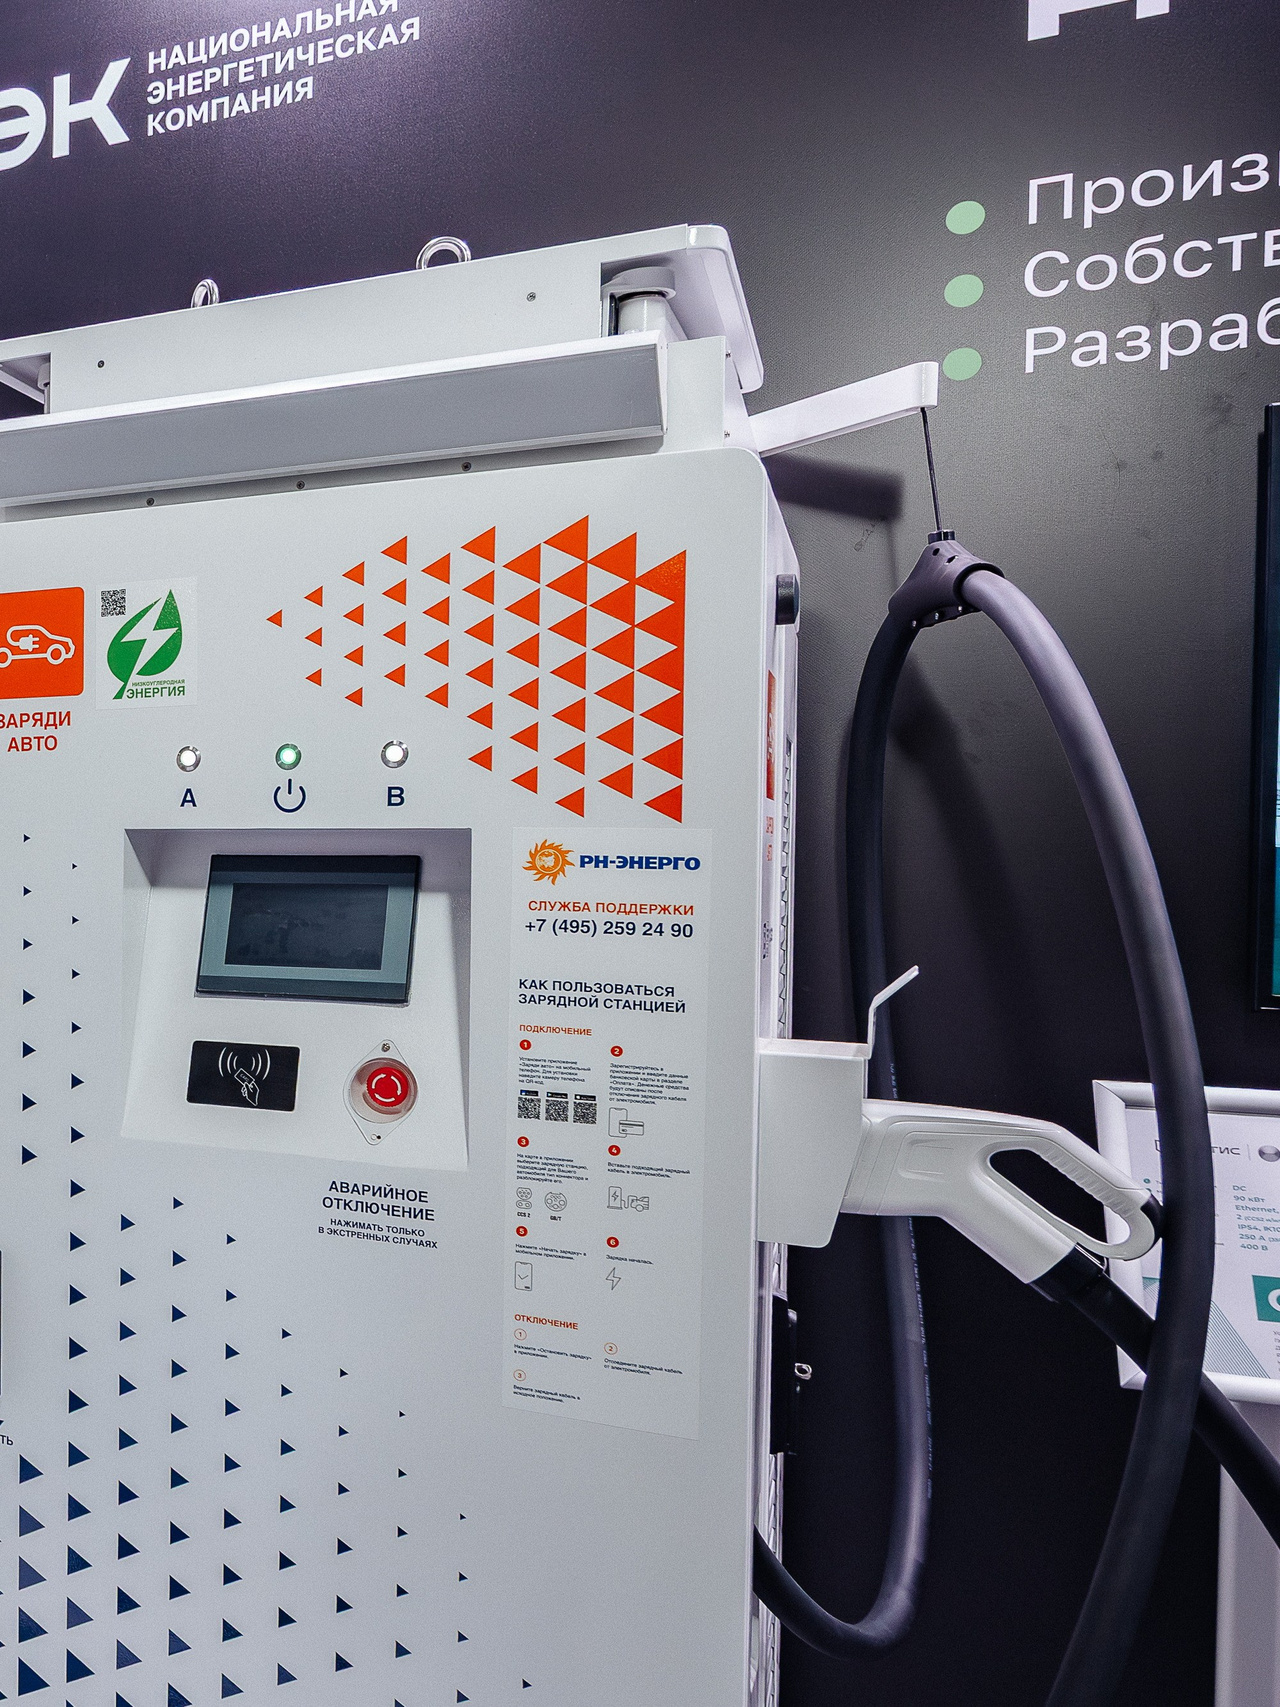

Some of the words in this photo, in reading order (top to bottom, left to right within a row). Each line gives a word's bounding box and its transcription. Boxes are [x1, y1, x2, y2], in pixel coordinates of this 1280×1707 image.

[148, 0, 401, 73] НАЦИОНАЛЬНАЯ
[147, 17, 421, 105] ЭНЕРГЕТИЧЕСКАЯ
[147, 77, 314, 136] КОМПАНИЯ
[1028, 149, 1280, 229] Произ
[132, 679, 185, 687] НИЗКОУГЛЕРОДНАЯ
[126, 686, 185, 699] ЭНЕРГИЯ
[8, 735, 58, 752] АВТО
[580, 855, 701, 870] РН-ЭНЕРГО
[528, 901, 591, 912] СЛУЖБА
[596, 902, 694, 916] ПОДДЕРЖКИ
[525, 919, 547, 932] +7
[552, 919, 597, 937] (495)
[603, 920, 636, 935] 259
[642, 922, 664, 936] 24
[671, 923, 693, 937] 90
[519, 979, 548, 990] КАК
[552, 981, 675, 997] ПОЛЬЗОВАТЬСЯ
[519, 994, 598, 1008] ЗАРЯДНОЙ
[603, 998, 686, 1013] СТАНЦИЕЙ
[519, 1024, 592, 1036] ПОДКЛЮЧЕНИЕ
[329, 1181, 428, 1203] АВАРИЙНОЕ
[322, 1197, 434, 1221] ОТКЛЮЧЕНИЕ
[331, 1218, 383, 1232] НАЖИМАТЬ
[386, 1226, 425, 1237] ТОЛЬКО
[327, 1228, 390, 1242] ЭКСТРЕННЫХ
[392, 1236, 438, 1248] СЛУЧАЯХ
[514, 1314, 578, 1330] ОТКЛЮЧЕНИЕ
